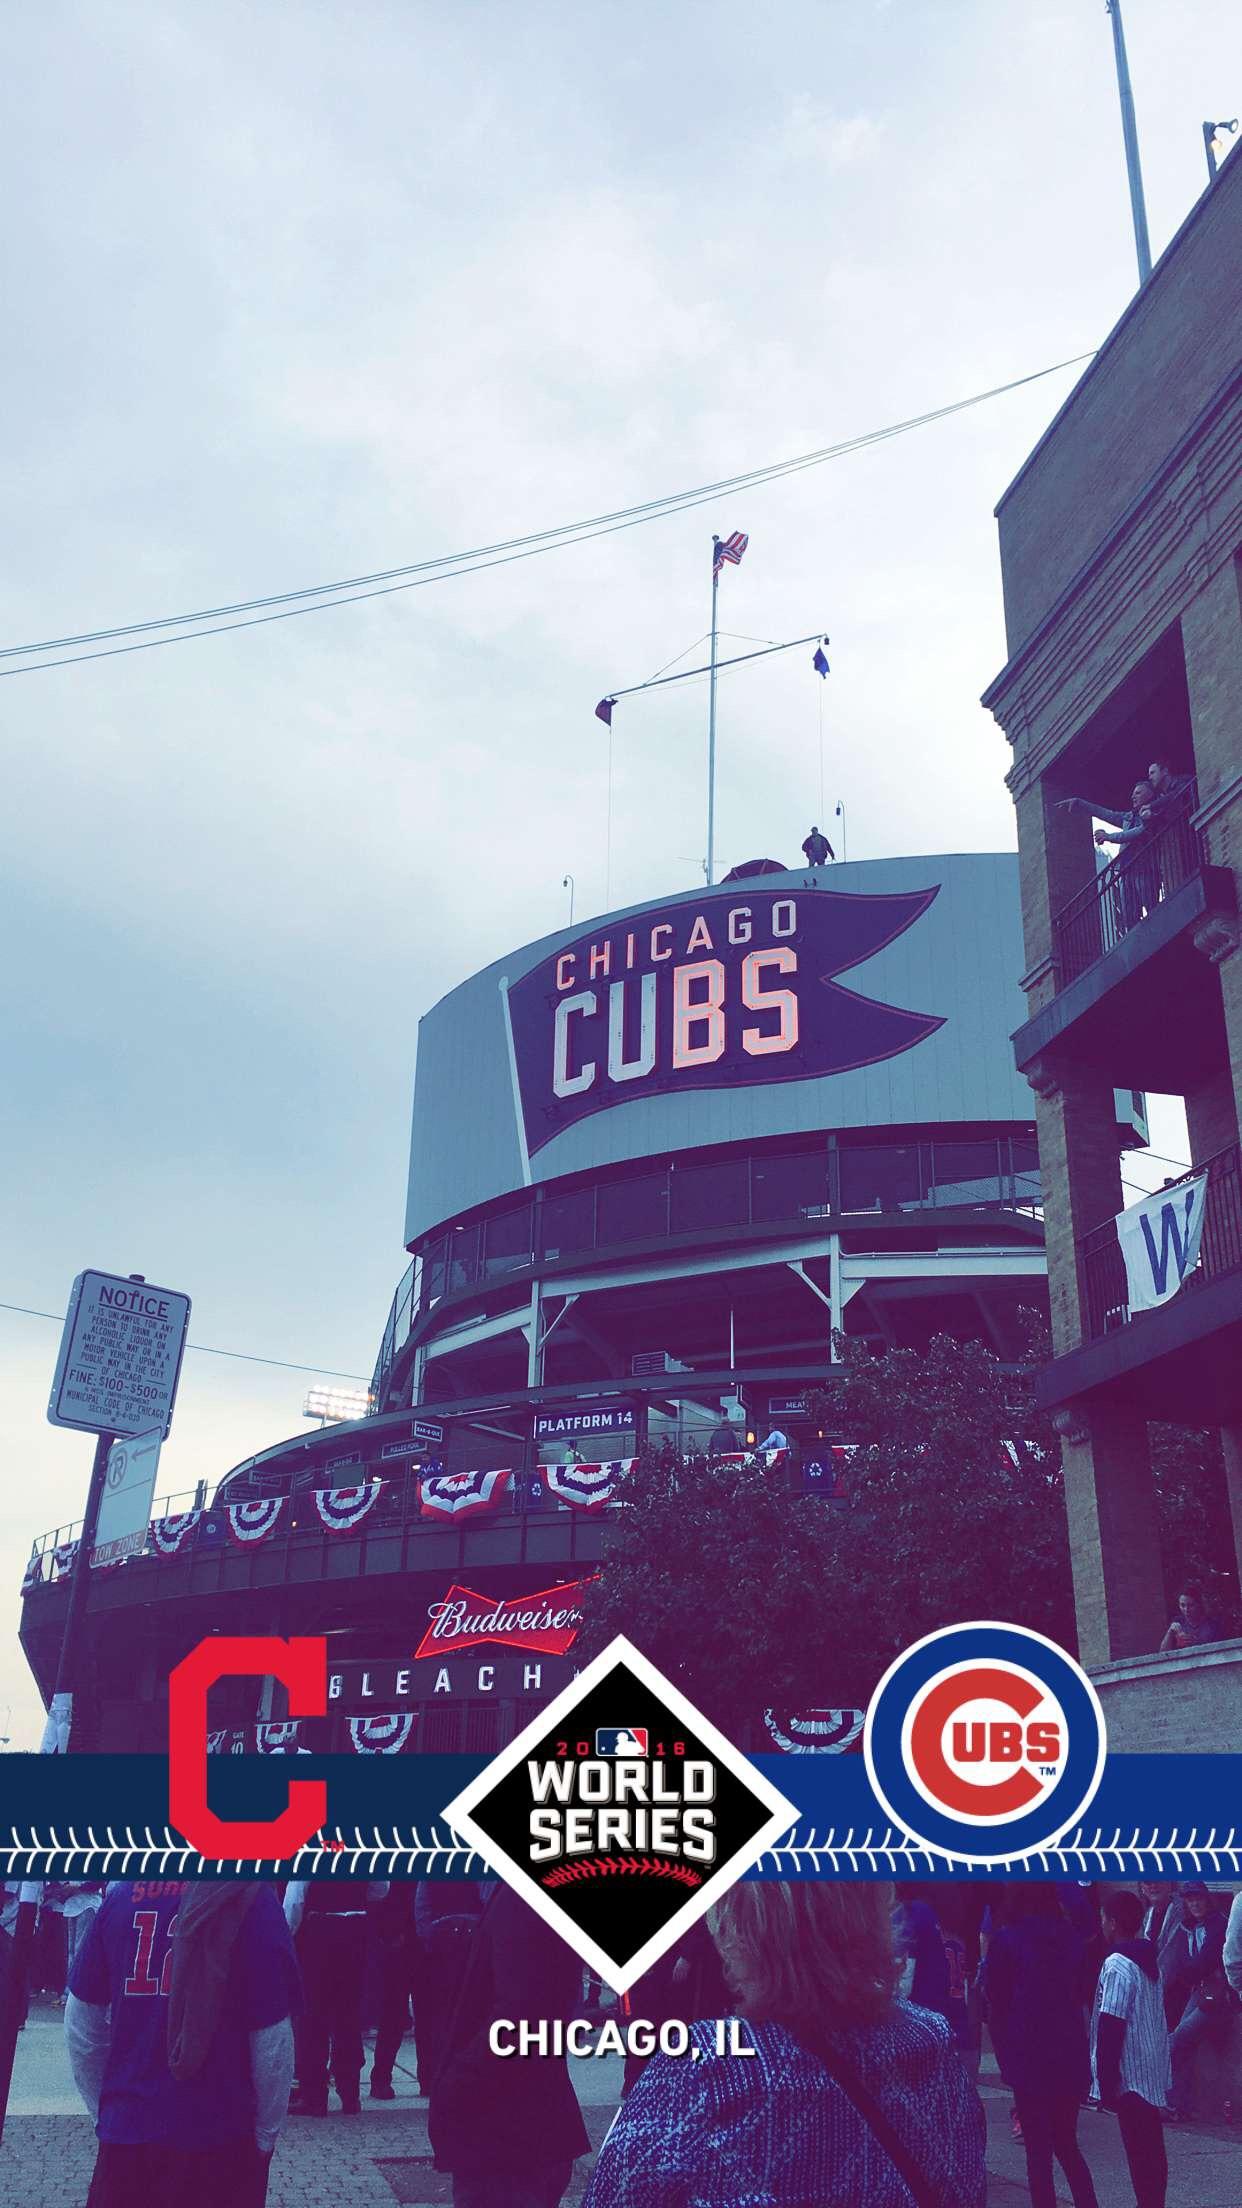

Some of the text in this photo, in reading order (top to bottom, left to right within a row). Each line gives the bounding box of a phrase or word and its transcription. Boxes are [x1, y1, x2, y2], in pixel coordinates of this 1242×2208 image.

[556, 899, 797, 991] CHICAGO
[553, 946, 799, 1099] CUBS
[1138, 1188, 1195, 1296] W
[99, 1286, 170, 1319] NOTICE
[92, 1316, 168, 1341] PERSON TO DRINK ANY
[108, 1310, 140, 1325] UNLAWFUL
[161, 1324, 174, 1333] ANY
[82, 1333, 96, 1343] ANY
[100, 1337, 122, 1349] PUBLIC
[126, 1343, 139, 1353] WAY
[155, 1351, 162, 1359] IN
[91, 1326, 166, 1350] ALCOHOLIC LIQUOR ON
[81, 1352, 164, 1378] PUBLIC WAY IN THE CITY
[84, 1343, 105, 1355] MOTOR
[110, 1349, 134, 1361] VEHICLE
[139, 1357, 156, 1367] UPON
[69, 1369, 97, 1386] FINE:
[159, 1391, 169, 1400] OR
[101, 1366, 142, 1382] OF CHICAGO
[67, 1389, 165, 1419] MUNICIPAL CODE OF CHICAGO
[88, 1405, 112, 1416] SECTION
[538, 1411, 633, 1433] PLATFORM 14
[328, 1663, 581, 1699] BLEACH
